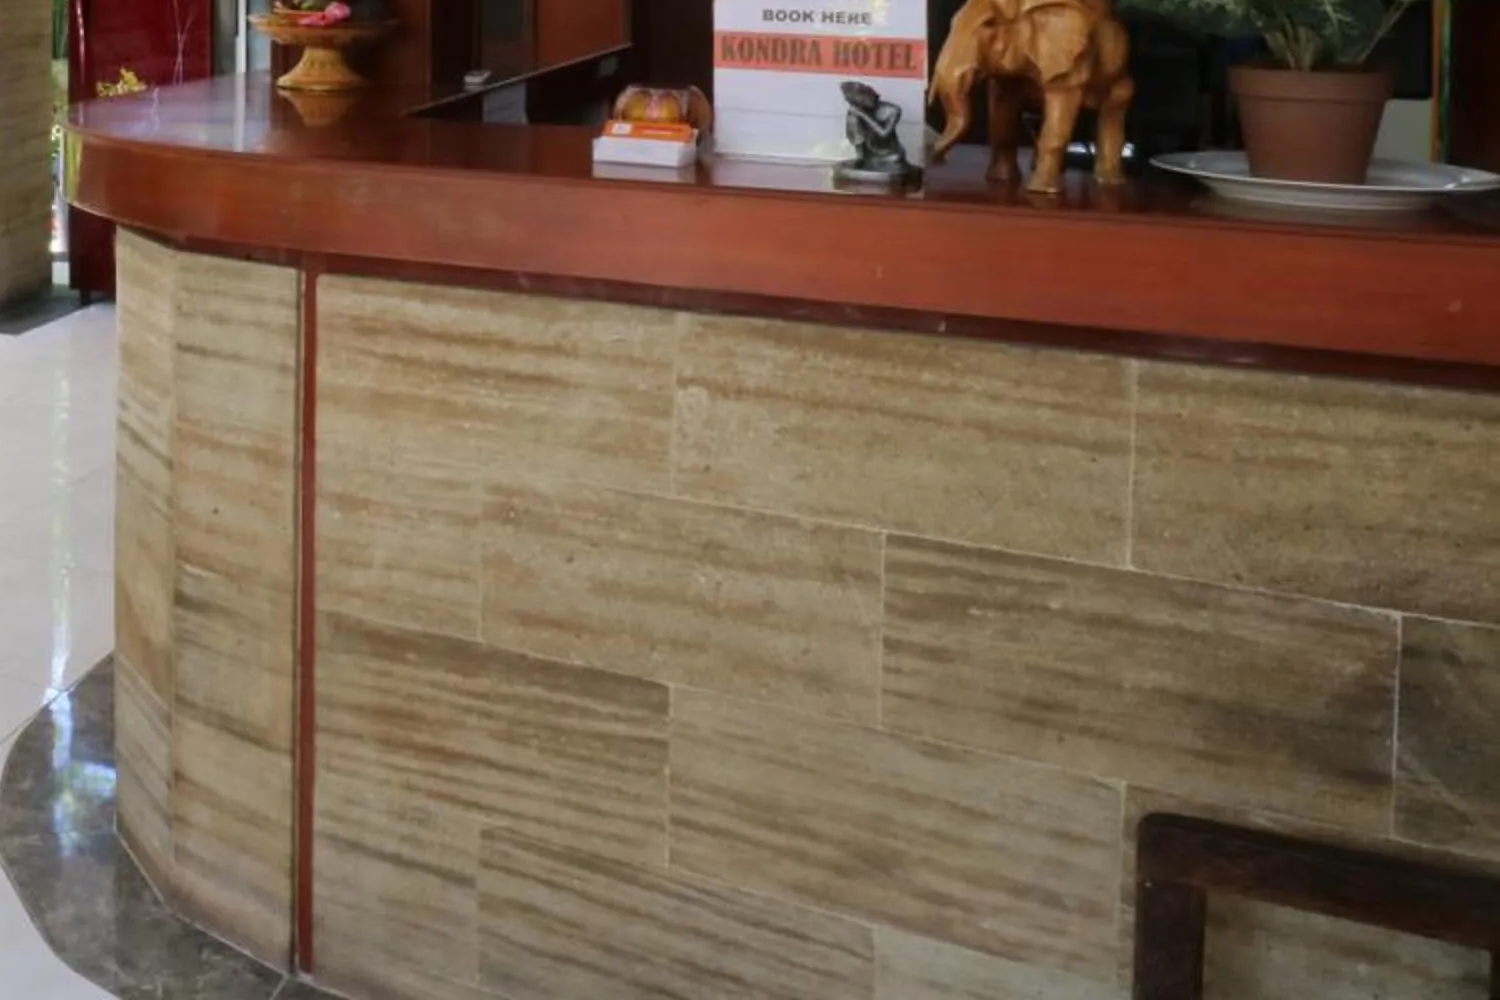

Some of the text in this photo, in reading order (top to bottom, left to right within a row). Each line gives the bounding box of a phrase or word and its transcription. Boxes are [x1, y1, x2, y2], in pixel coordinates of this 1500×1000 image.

[762, 8, 873, 25] BOOK HERE
[720, 34, 917, 71] KONDRA HOTEL
